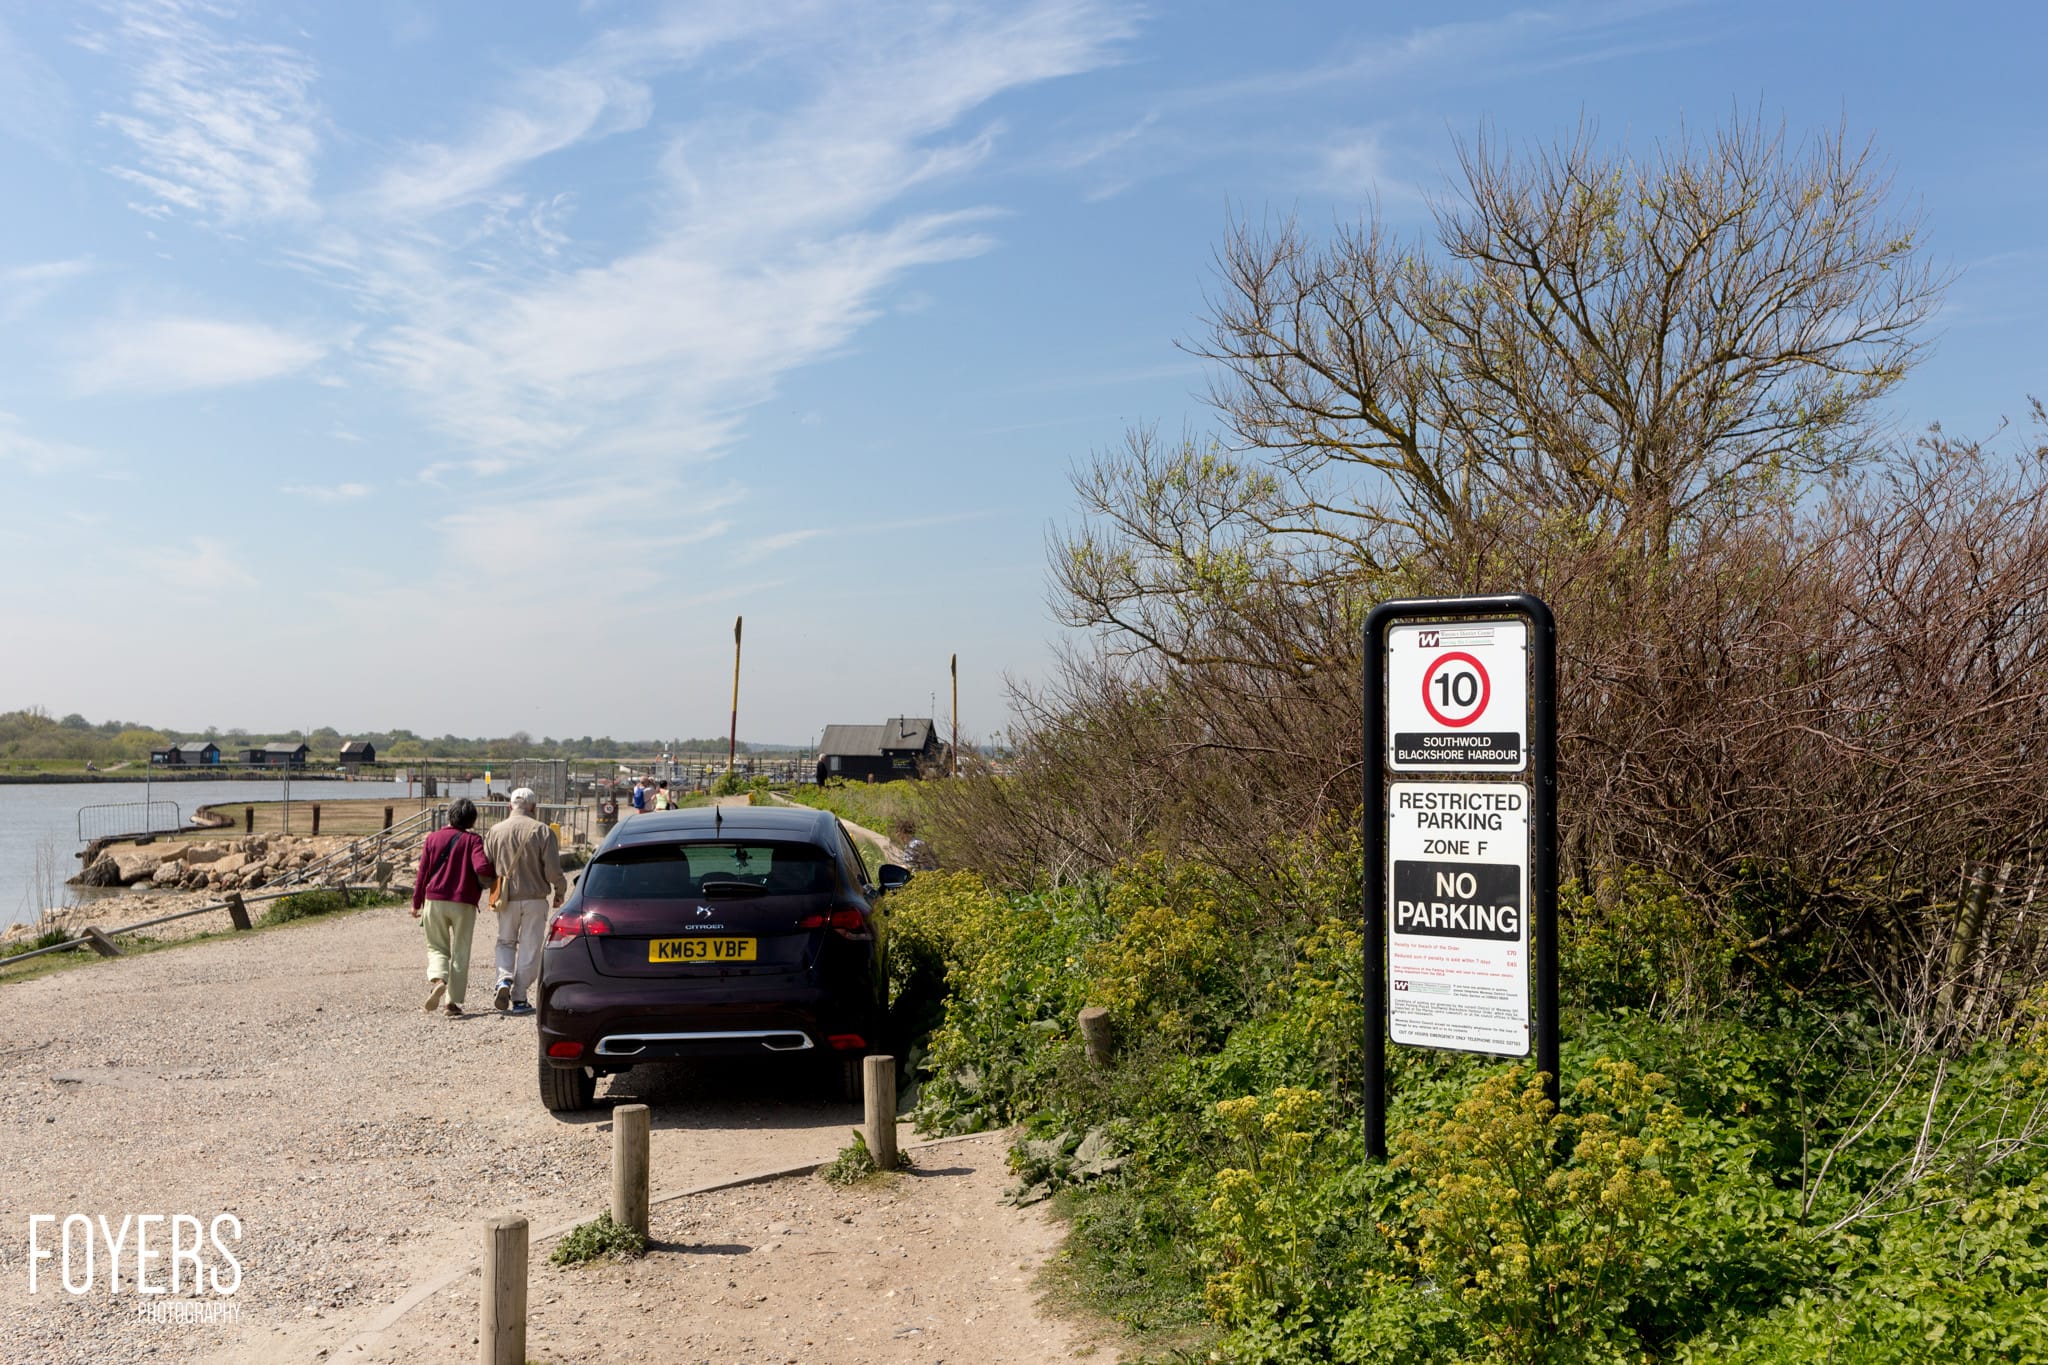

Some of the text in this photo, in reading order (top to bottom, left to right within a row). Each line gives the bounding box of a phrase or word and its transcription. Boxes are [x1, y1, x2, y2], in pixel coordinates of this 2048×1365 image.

[1434, 672, 1478, 706] 10
[1423, 736, 1492, 747] SOUTHWOLD
[1398, 750, 1518, 760] BLACKSHORE HARBOUR
[1400, 792, 1522, 811] RESTRICTED
[1418, 812, 1502, 830] PARKING
[1424, 839, 1488, 856] ZONE F
[1436, 872, 1478, 899] NO
[1398, 900, 1518, 934] PARKING
[658, 940, 749, 959] KM63 VBF
